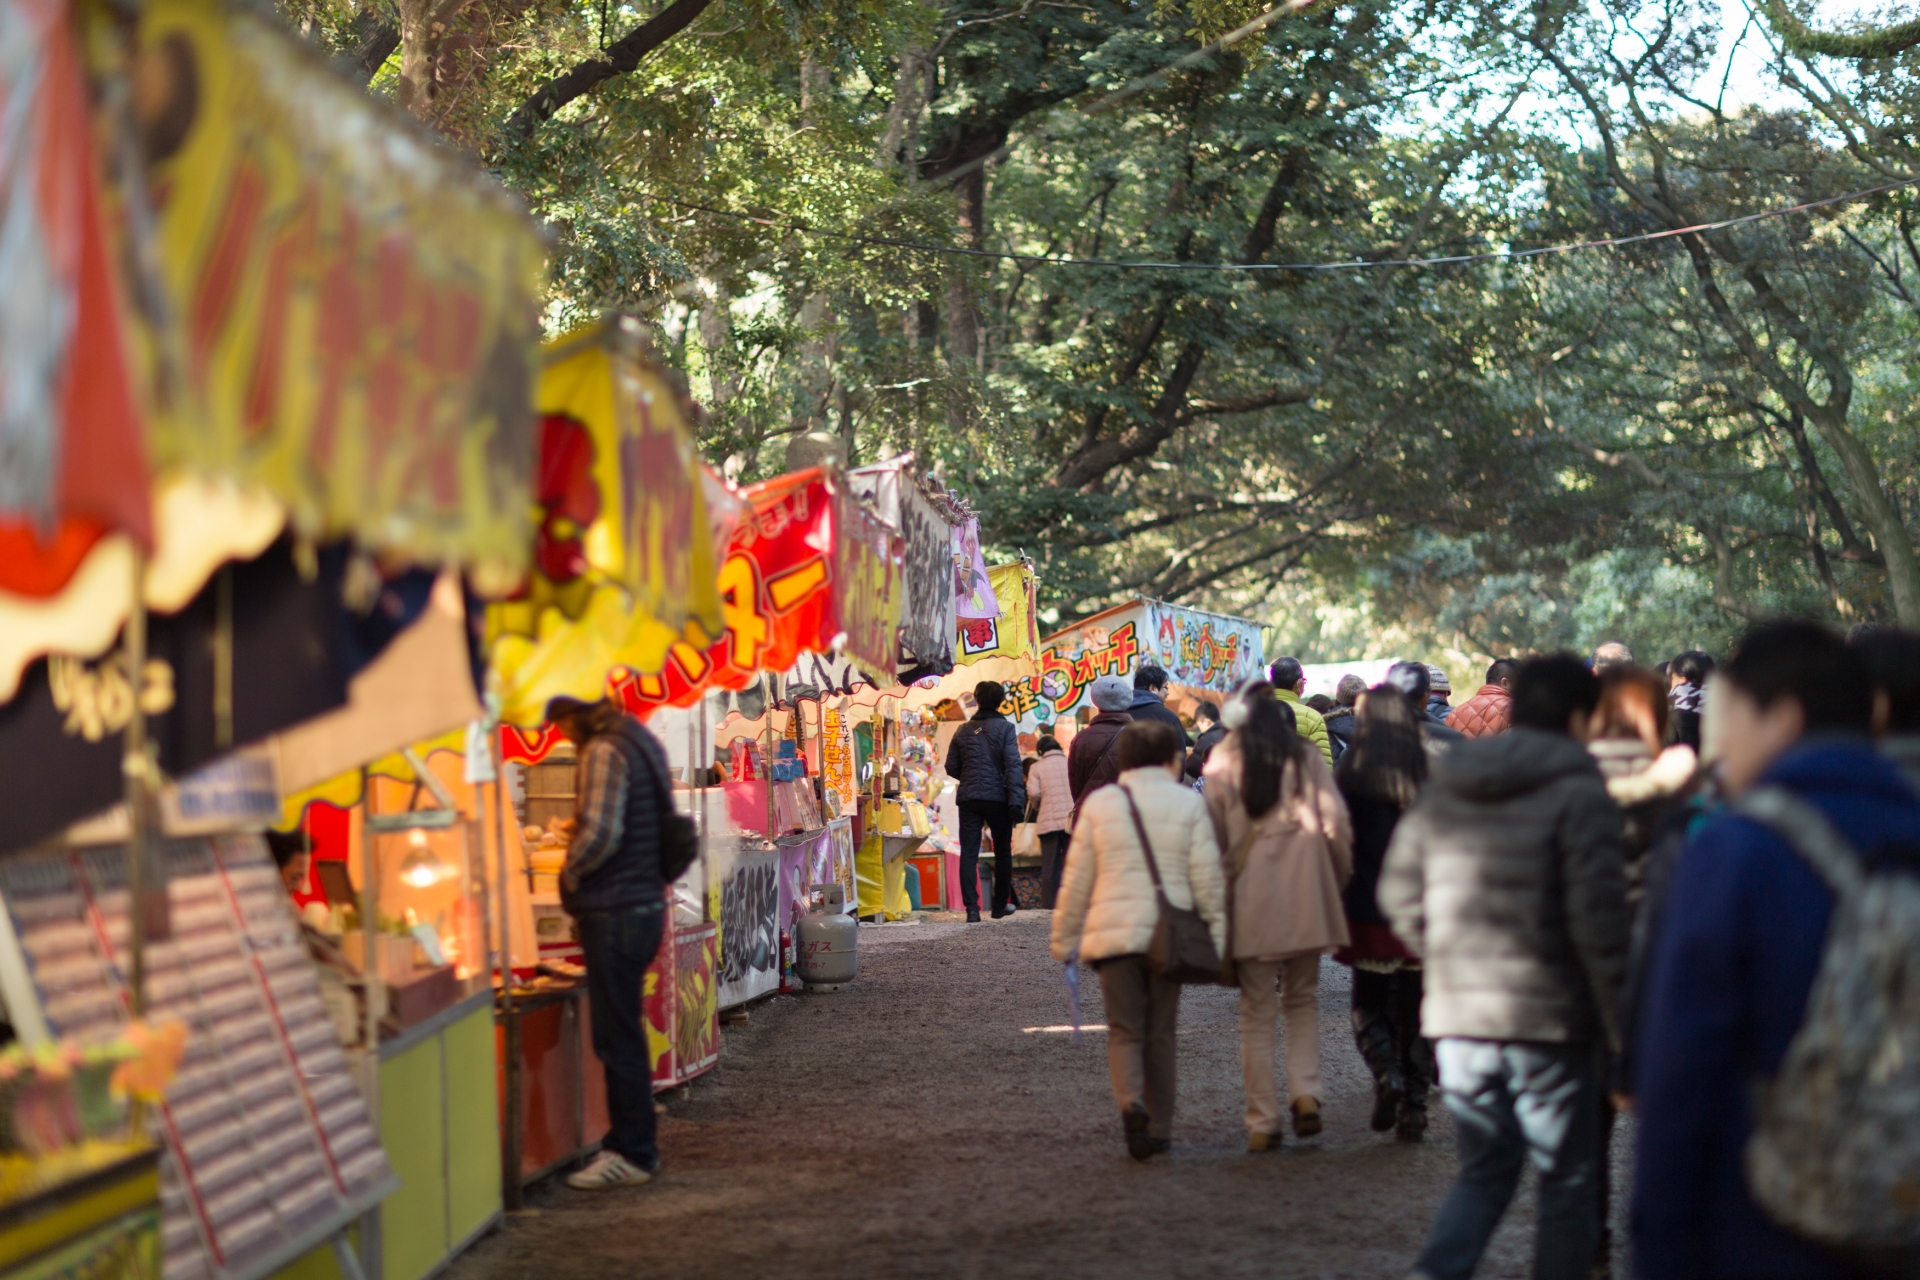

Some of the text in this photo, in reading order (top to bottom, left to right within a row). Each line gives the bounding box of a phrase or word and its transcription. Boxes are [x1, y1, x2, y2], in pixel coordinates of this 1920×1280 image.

[998, 620, 1139, 723] 怪ウォッチ
